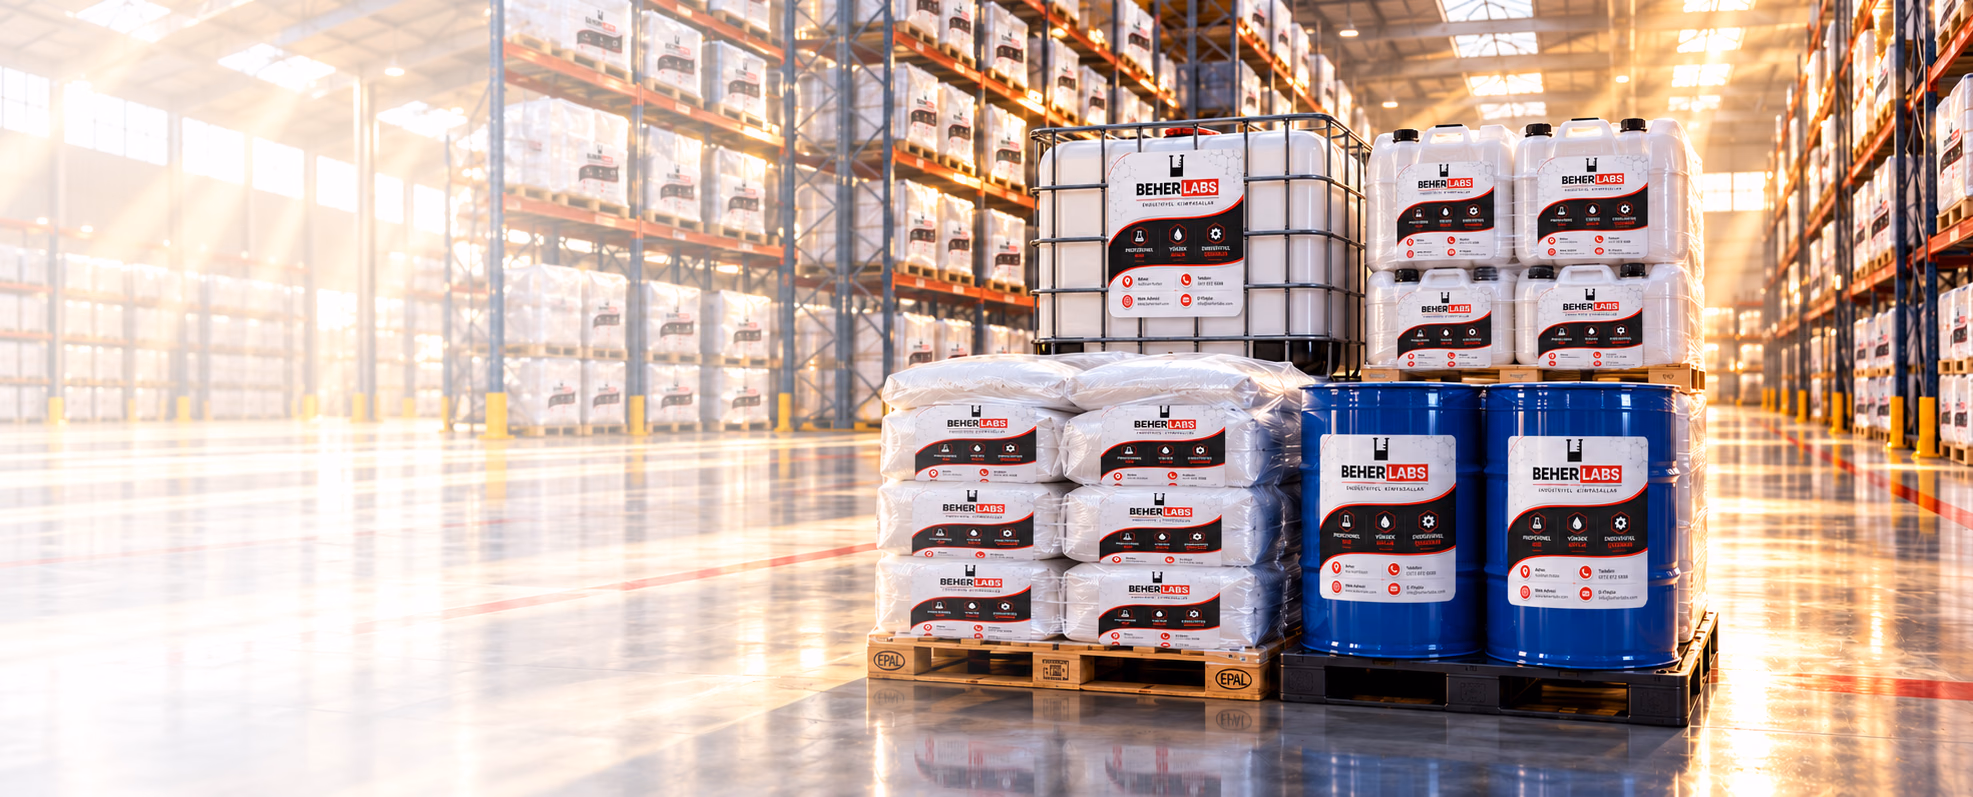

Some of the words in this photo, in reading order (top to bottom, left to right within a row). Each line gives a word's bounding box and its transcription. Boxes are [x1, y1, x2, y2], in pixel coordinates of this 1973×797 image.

[1448, 179, 1472, 187] LABS
[1562, 175, 1594, 184] BEHER
[1596, 174, 1623, 183] LABS
[1136, 182, 1180, 196] BEHER
[1183, 182, 1217, 194] LABS
[1422, 305, 1448, 313] BEHER
[1563, 303, 1593, 311] BEHER
[947, 419, 979, 428] BEHER
[1134, 420, 1167, 428] BEHER
[1341, 465, 1385, 479] BEHER
[1389, 466, 1426, 479] LABS
[1532, 467, 1579, 480] BEHER
[1582, 468, 1619, 480] LABS
[942, 504, 975, 512] BEHER
[1130, 507, 1162, 516] BEHER
[1165, 508, 1191, 516] LABS
[878, 654, 900, 667] EPAL
[1220, 672, 1248, 686] EPAL
